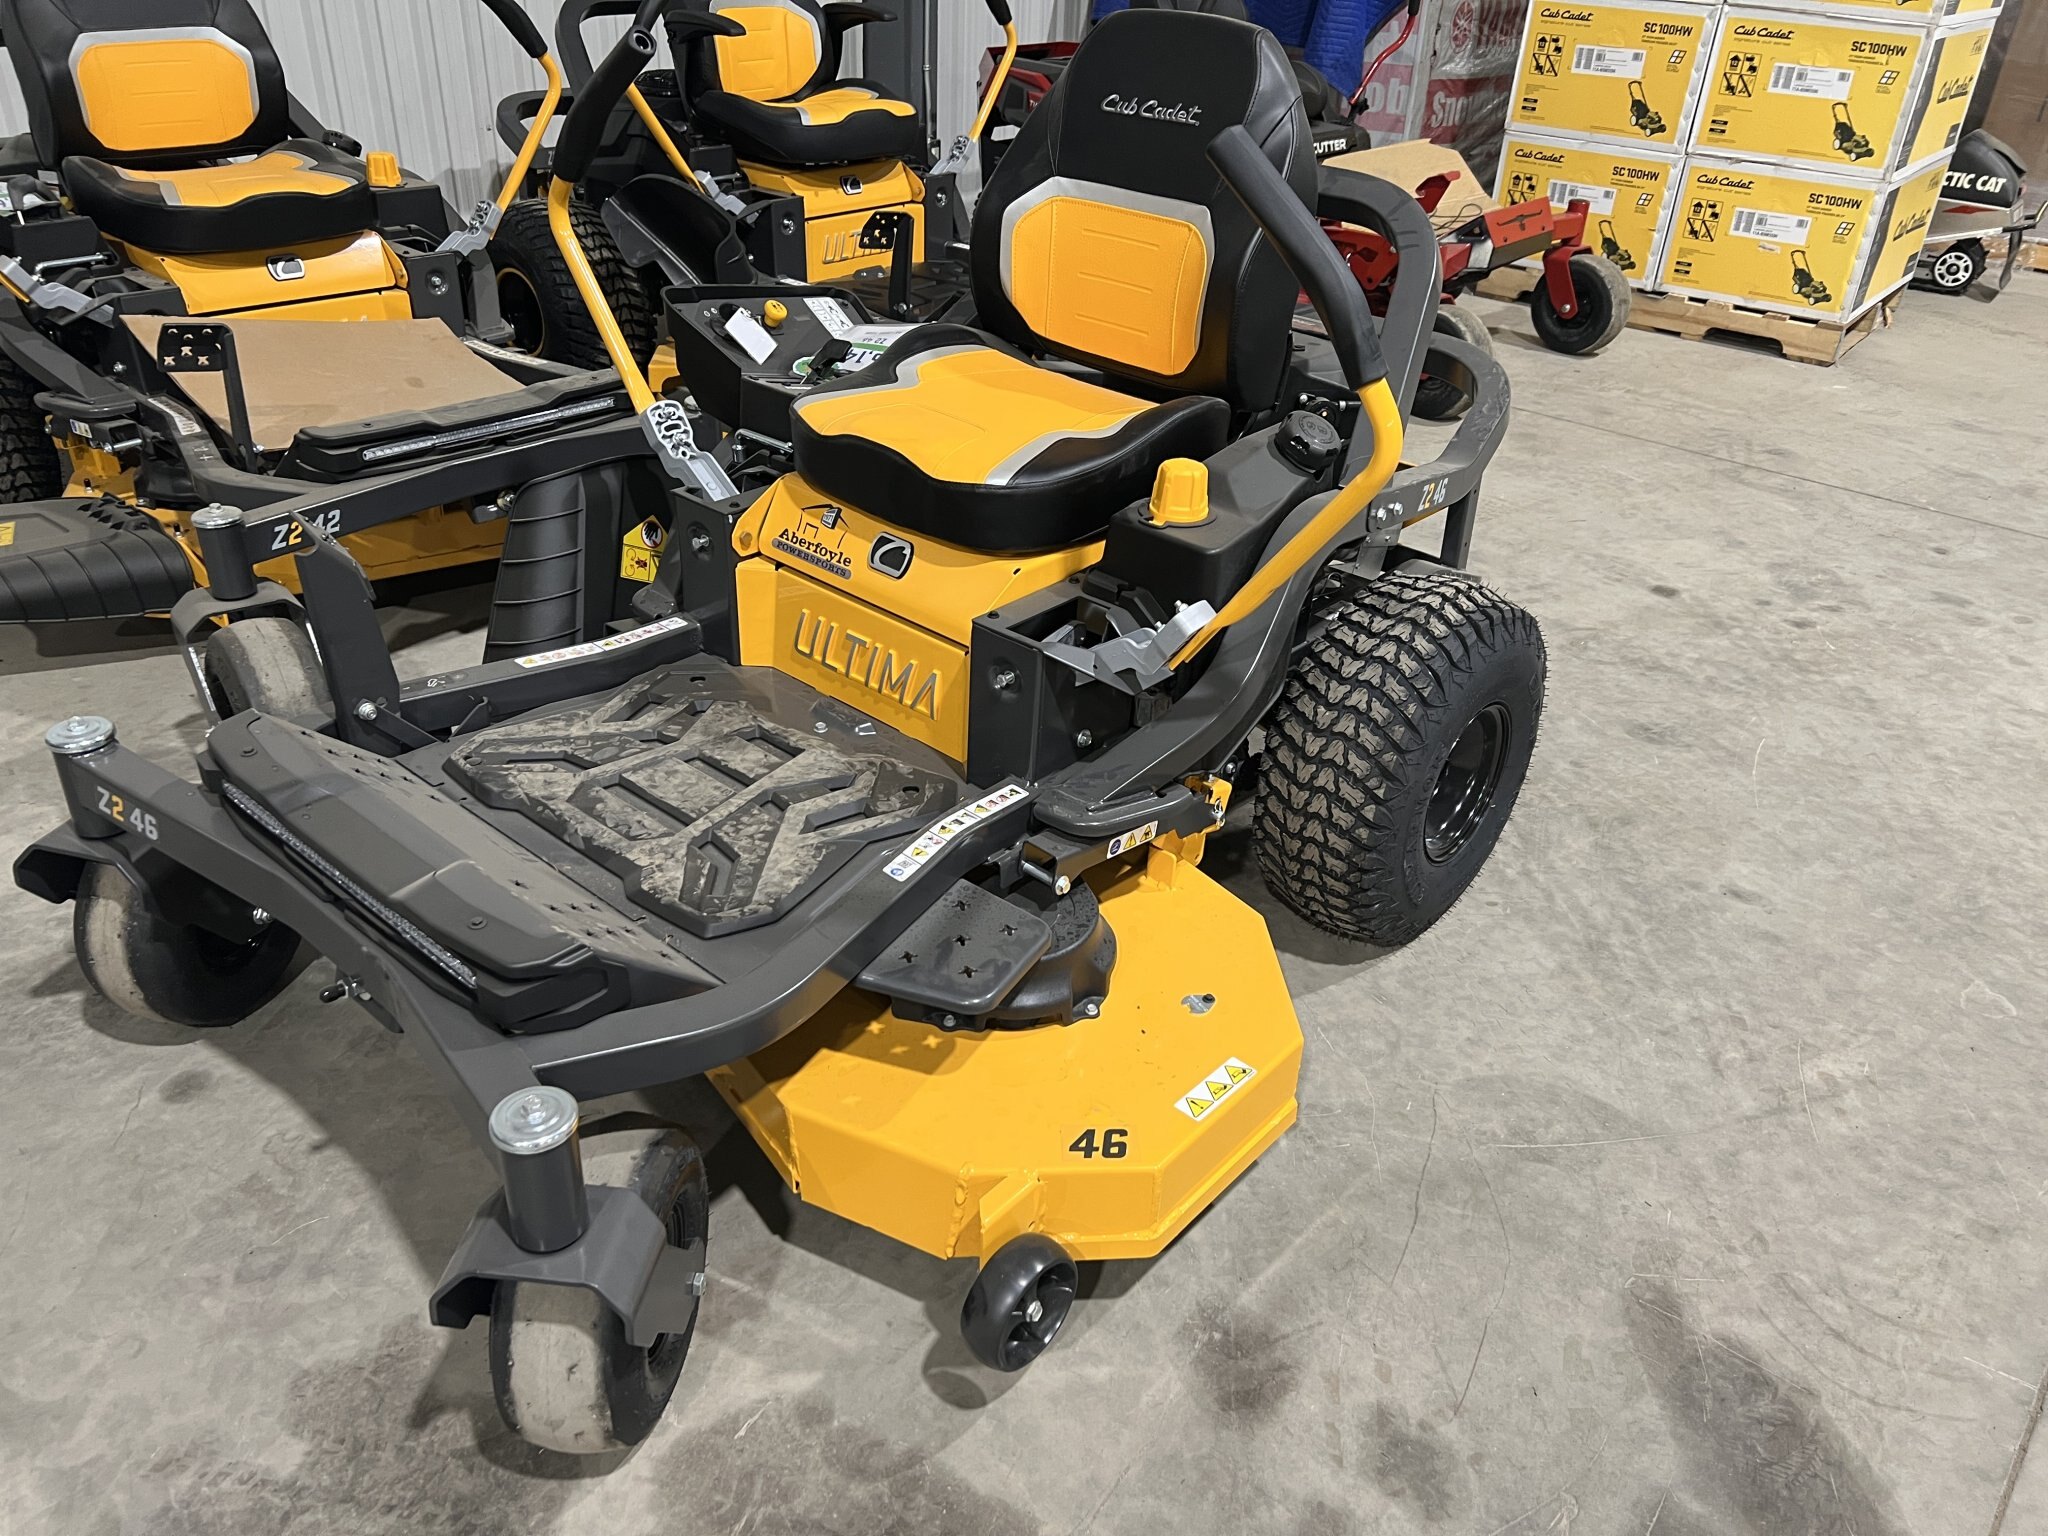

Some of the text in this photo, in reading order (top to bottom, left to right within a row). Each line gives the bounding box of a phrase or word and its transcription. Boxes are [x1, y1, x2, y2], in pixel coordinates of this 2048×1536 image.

[1541, 8, 1594, 21] Cub Cadet
[1734, 25, 1794, 39] Cub Cadet
[1101, 94, 1202, 125] Cub Cadet
[1514, 149, 1534, 160] Cub
[1533, 152, 1565, 164] Cadet
[1697, 174, 1755, 189] Cub Cadet
[1943, 171, 1976, 189] CTIC
[1976, 175, 2007, 193] CAT
[1417, 477, 1449, 512] Z2 46
[271, 521, 303, 551] Z2
[778, 528, 852, 568] Aberfoyle
[775, 541, 848, 577] POWERSPORTS
[794, 608, 944, 721] ULTIMA
[97, 785, 159, 841] Z2 46
[1068, 1128, 1129, 1159] 46
